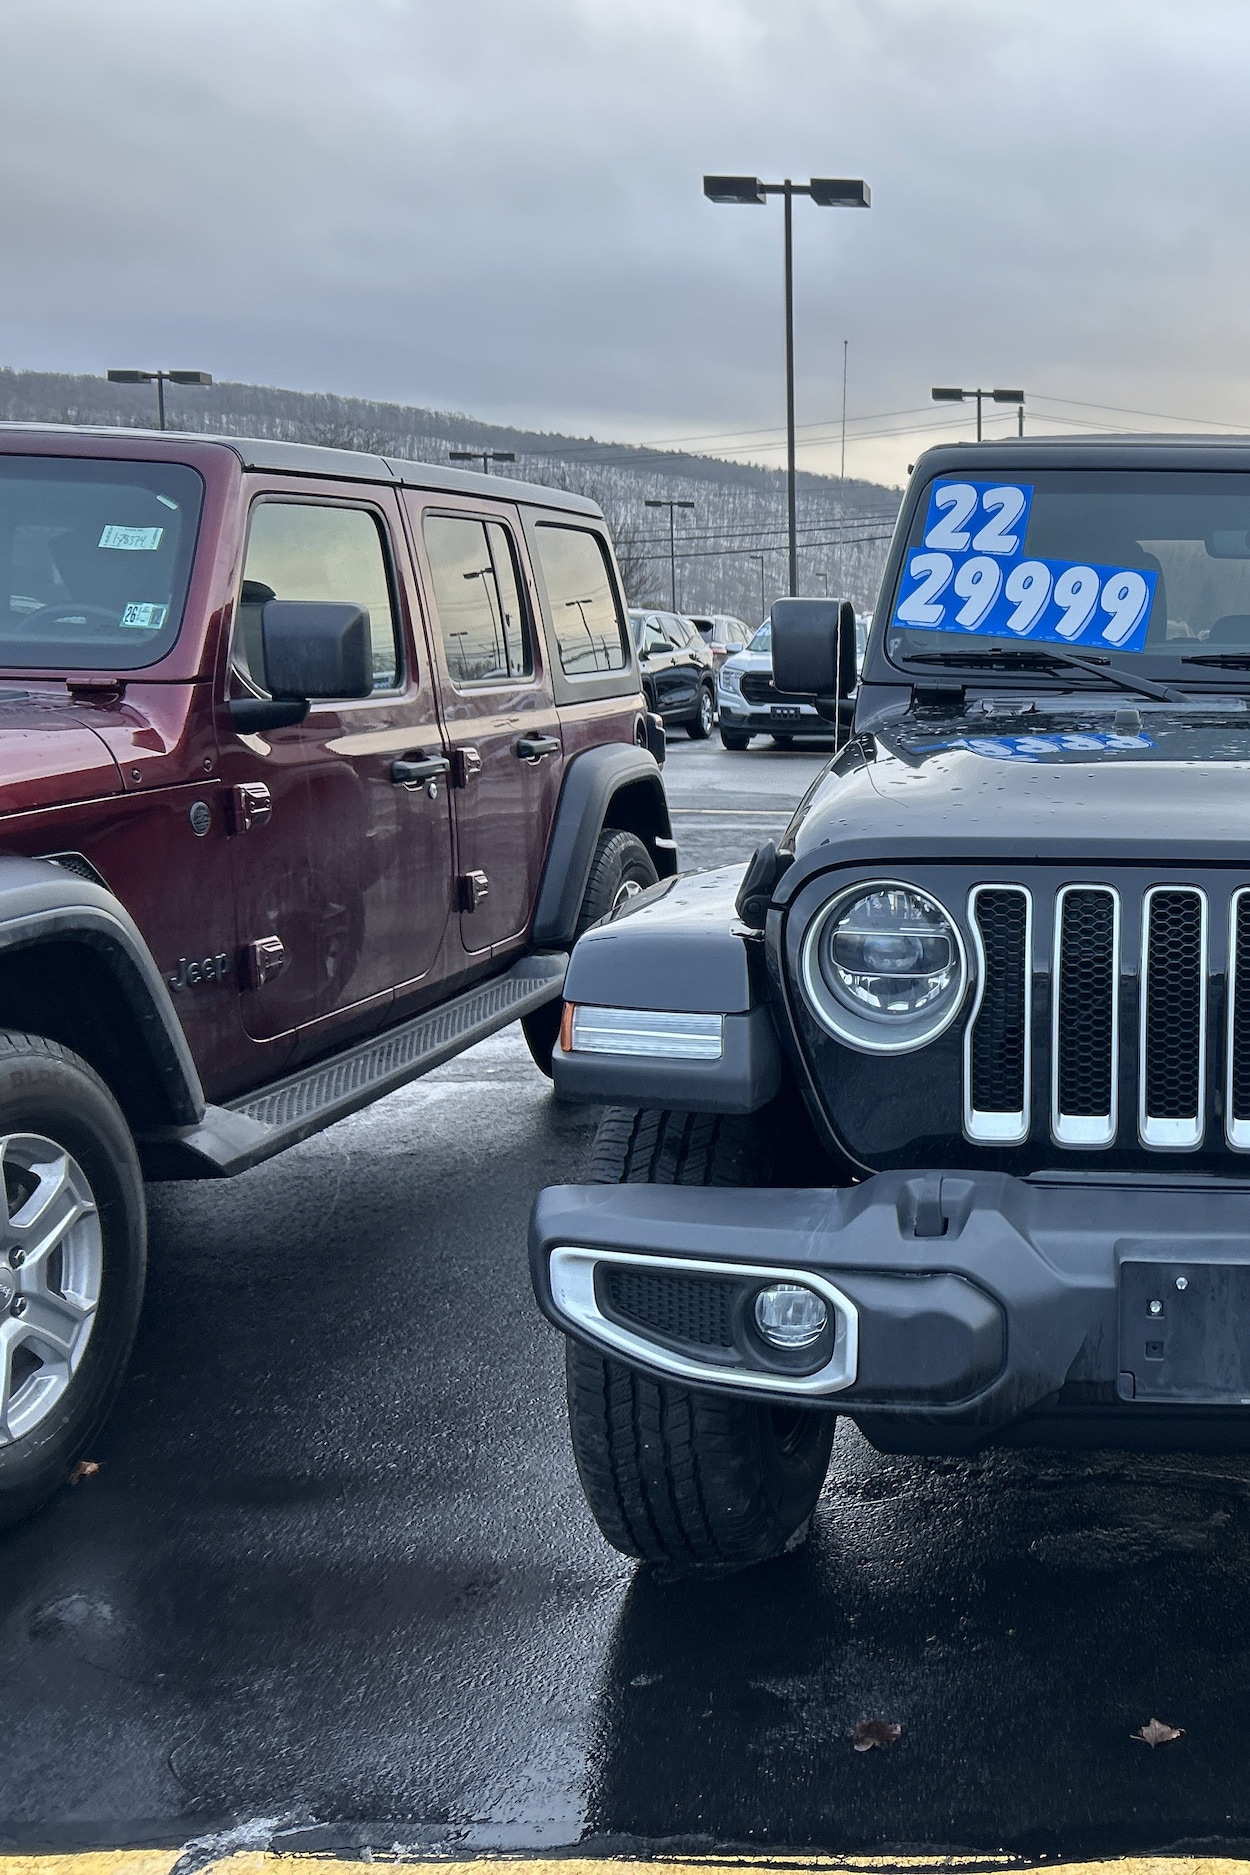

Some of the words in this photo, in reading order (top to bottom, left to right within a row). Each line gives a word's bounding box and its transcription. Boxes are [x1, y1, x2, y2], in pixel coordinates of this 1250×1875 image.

[925, 484, 1026, 556] 22
[124, 606, 138, 623] 26
[897, 552, 1150, 647] 29999
[168, 953, 230, 993] Jeep
